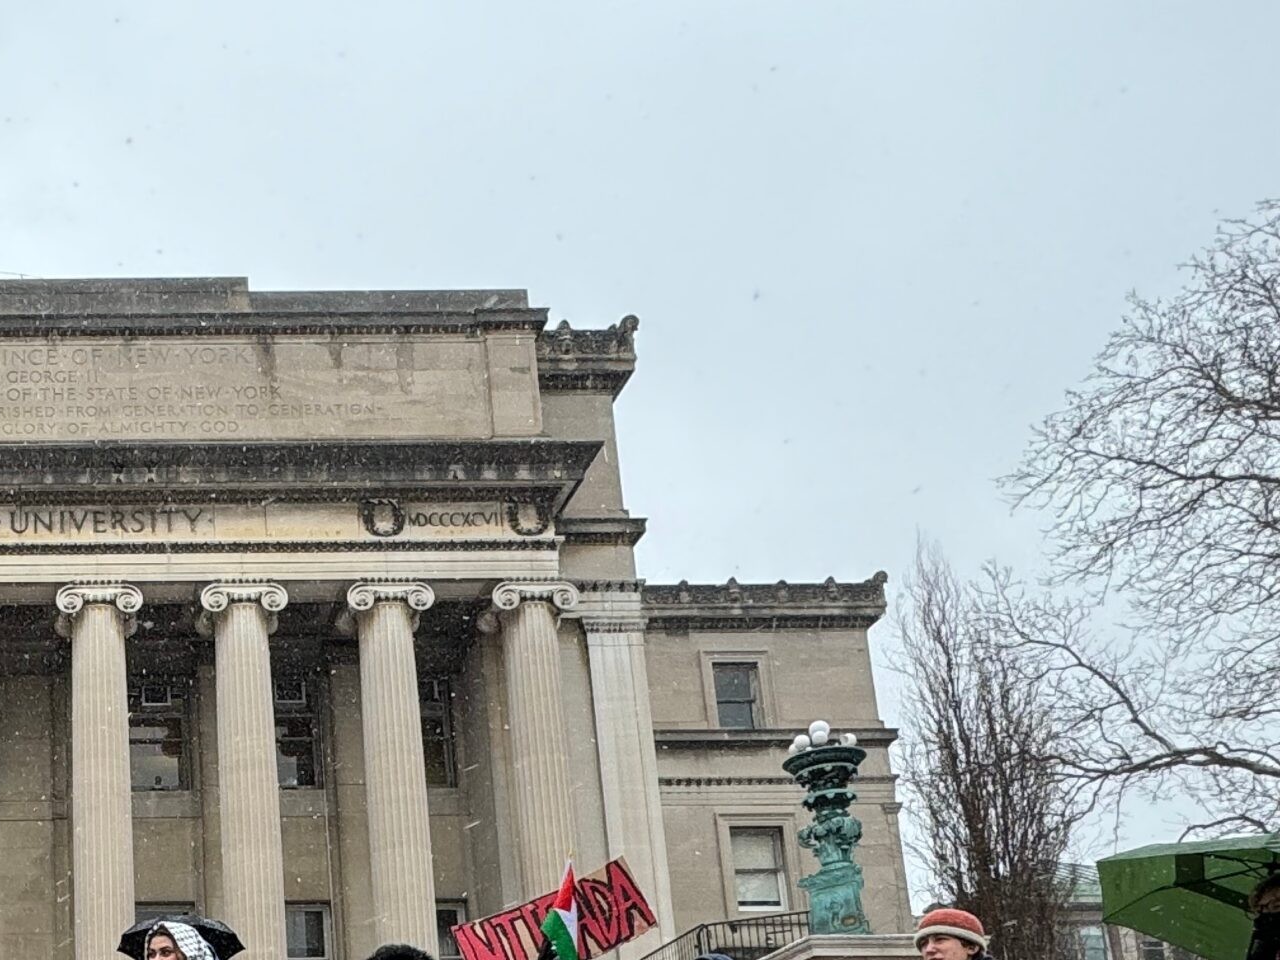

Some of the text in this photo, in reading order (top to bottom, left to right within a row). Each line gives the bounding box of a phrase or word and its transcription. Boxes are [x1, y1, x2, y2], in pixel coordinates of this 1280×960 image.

[72, 348, 102, 366] OF
[118, 348, 170, 365] NEW
[184, 347, 252, 365] YORK
[6, 370, 77, 383] GEORGE
[87, 370, 99, 383] II
[6, 388, 32, 401] OF
[39, 388, 77, 401] THE
[87, 387, 138, 401] STATE
[147, 387, 172, 400] OF
[181, 386, 221, 400] NEW
[232, 386, 282, 400] YORK
[66, 406, 112, 418] FROM
[122, 404, 228, 417] GENERATION
[237, 404, 259, 416] TO
[2, 423, 56, 435] GLORY
[66, 422, 89, 434] OF
[98, 421, 189, 434] ALMIGHTY
[200, 421, 239, 433] GOD
[10, 509, 204, 534] UNIVERSITY
